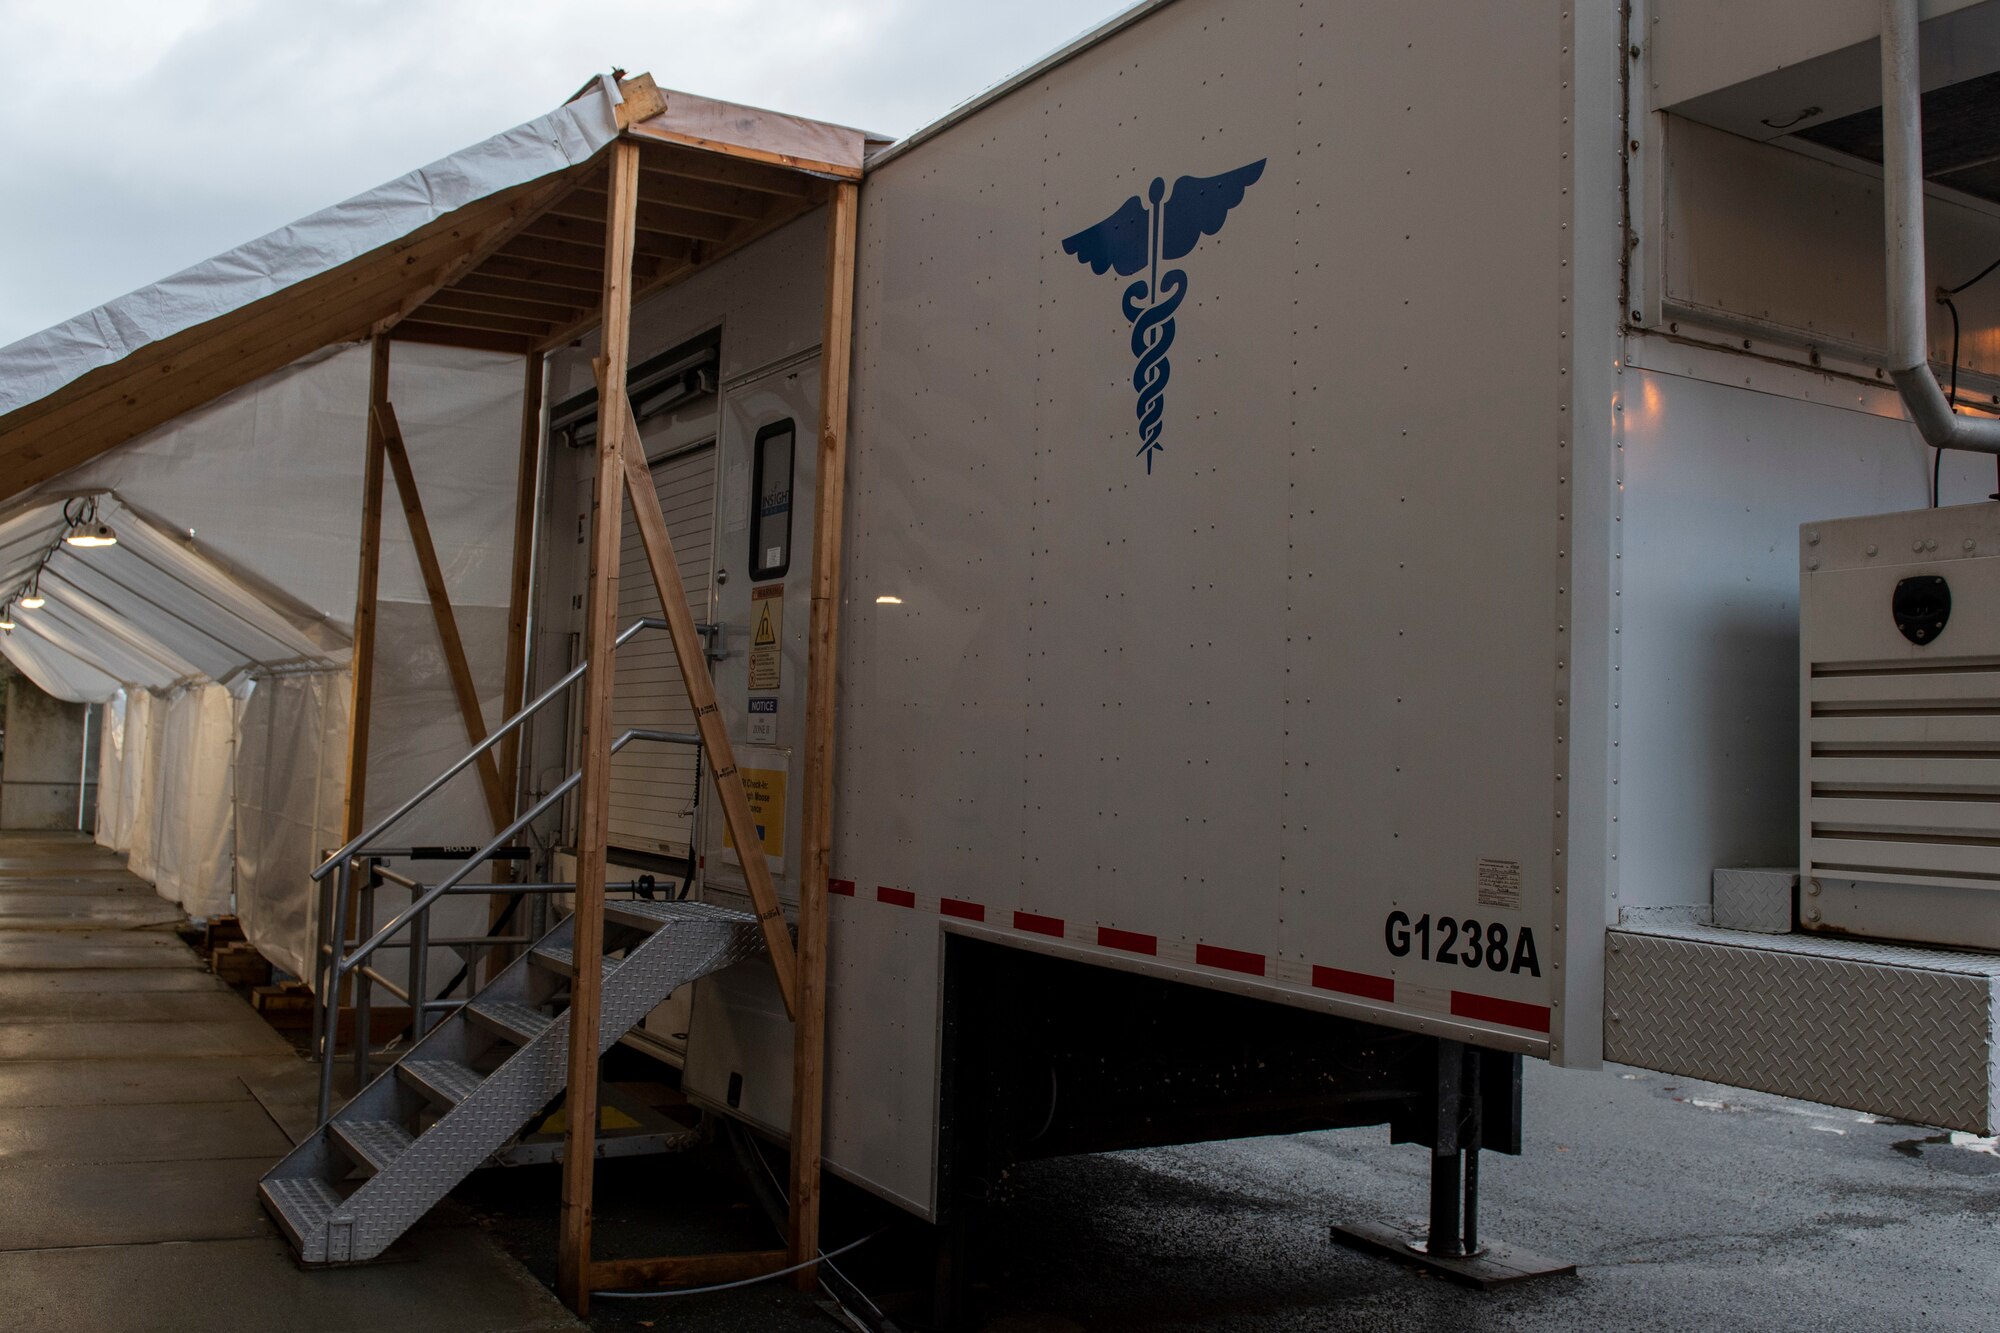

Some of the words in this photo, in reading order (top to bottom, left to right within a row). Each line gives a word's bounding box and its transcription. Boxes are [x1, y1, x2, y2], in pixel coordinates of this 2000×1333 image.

[752, 702, 773, 711] NOTICE
[755, 792, 769, 802] Moose
[1385, 910, 1541, 978] G1238A
